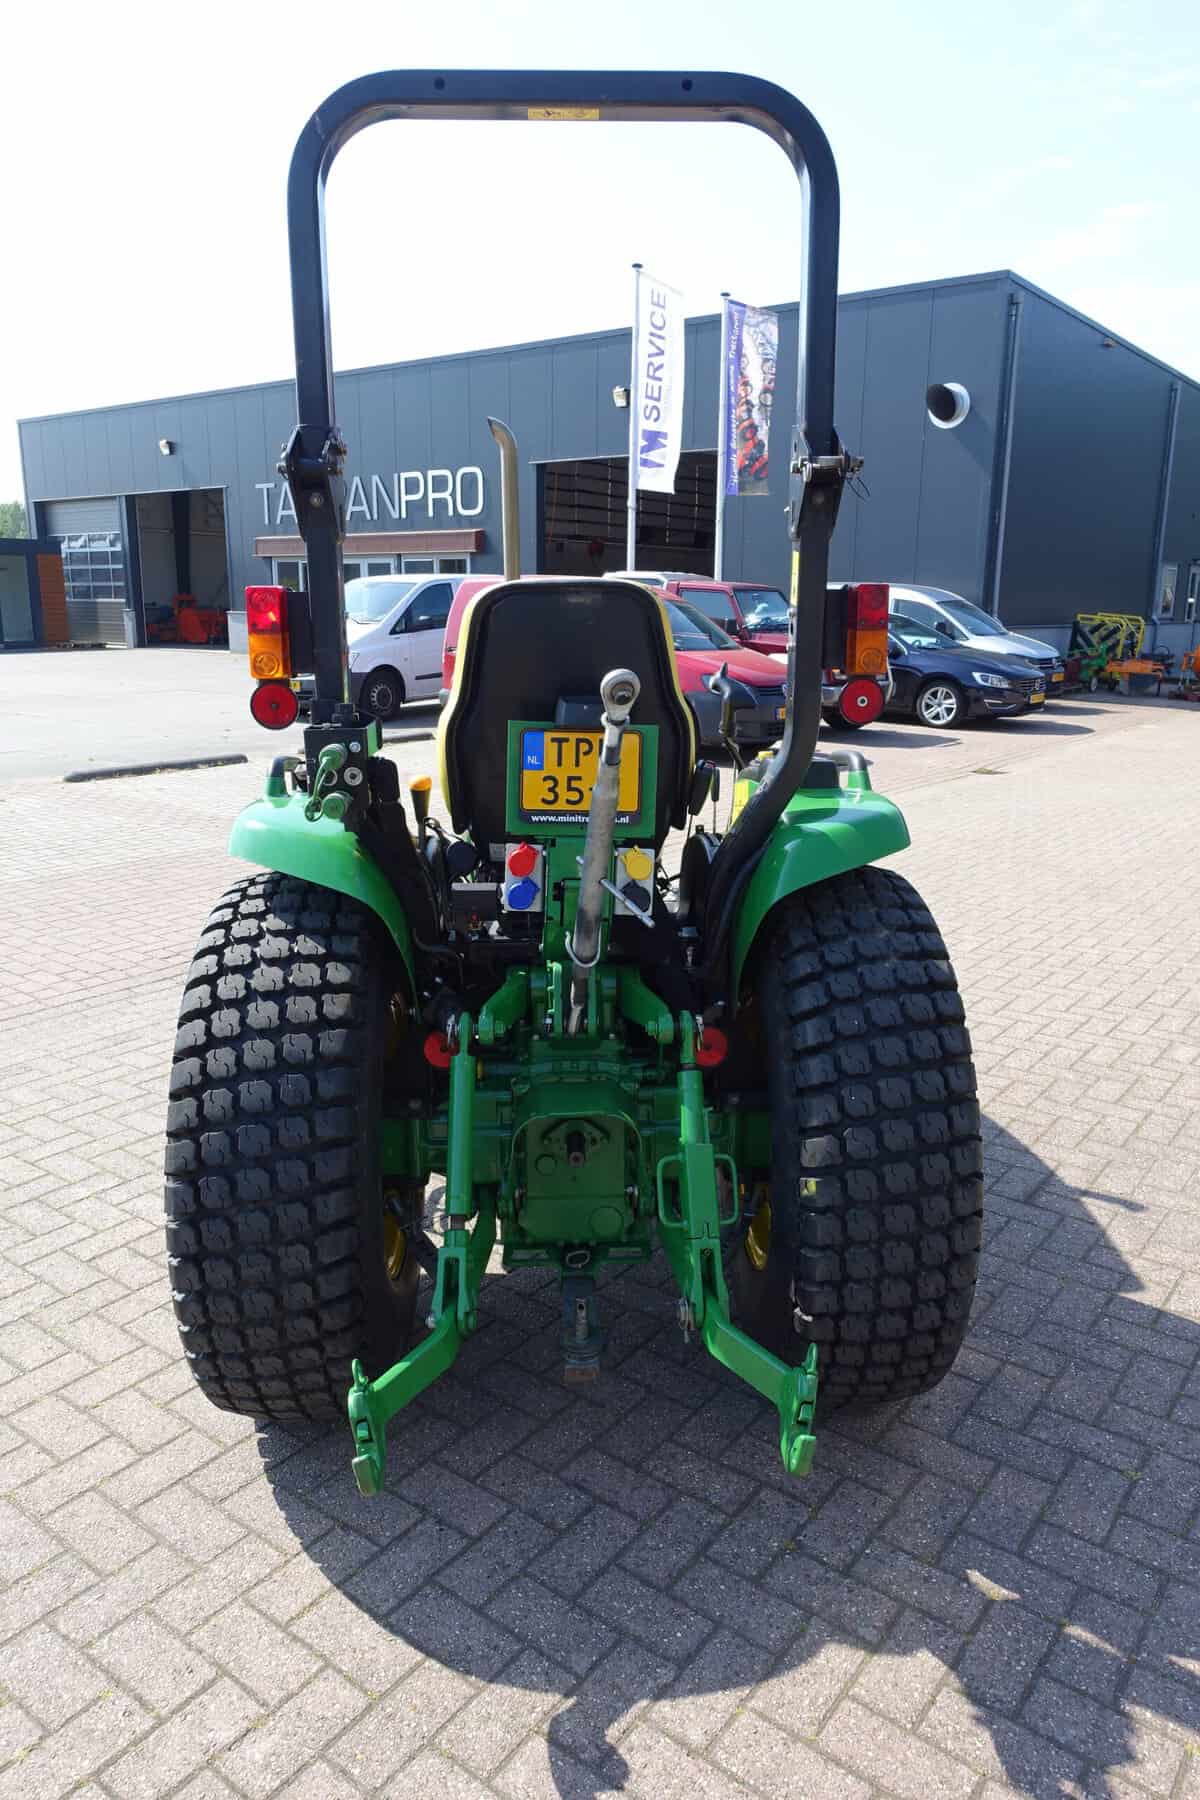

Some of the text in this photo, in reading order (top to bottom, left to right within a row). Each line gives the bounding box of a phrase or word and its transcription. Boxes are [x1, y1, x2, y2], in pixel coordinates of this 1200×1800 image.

[643, 288, 666, 422] SERVICE
[254, 465, 485, 525] TAANPRO
[527, 755, 541, 765] NL
[550, 736, 604, 768] TP
